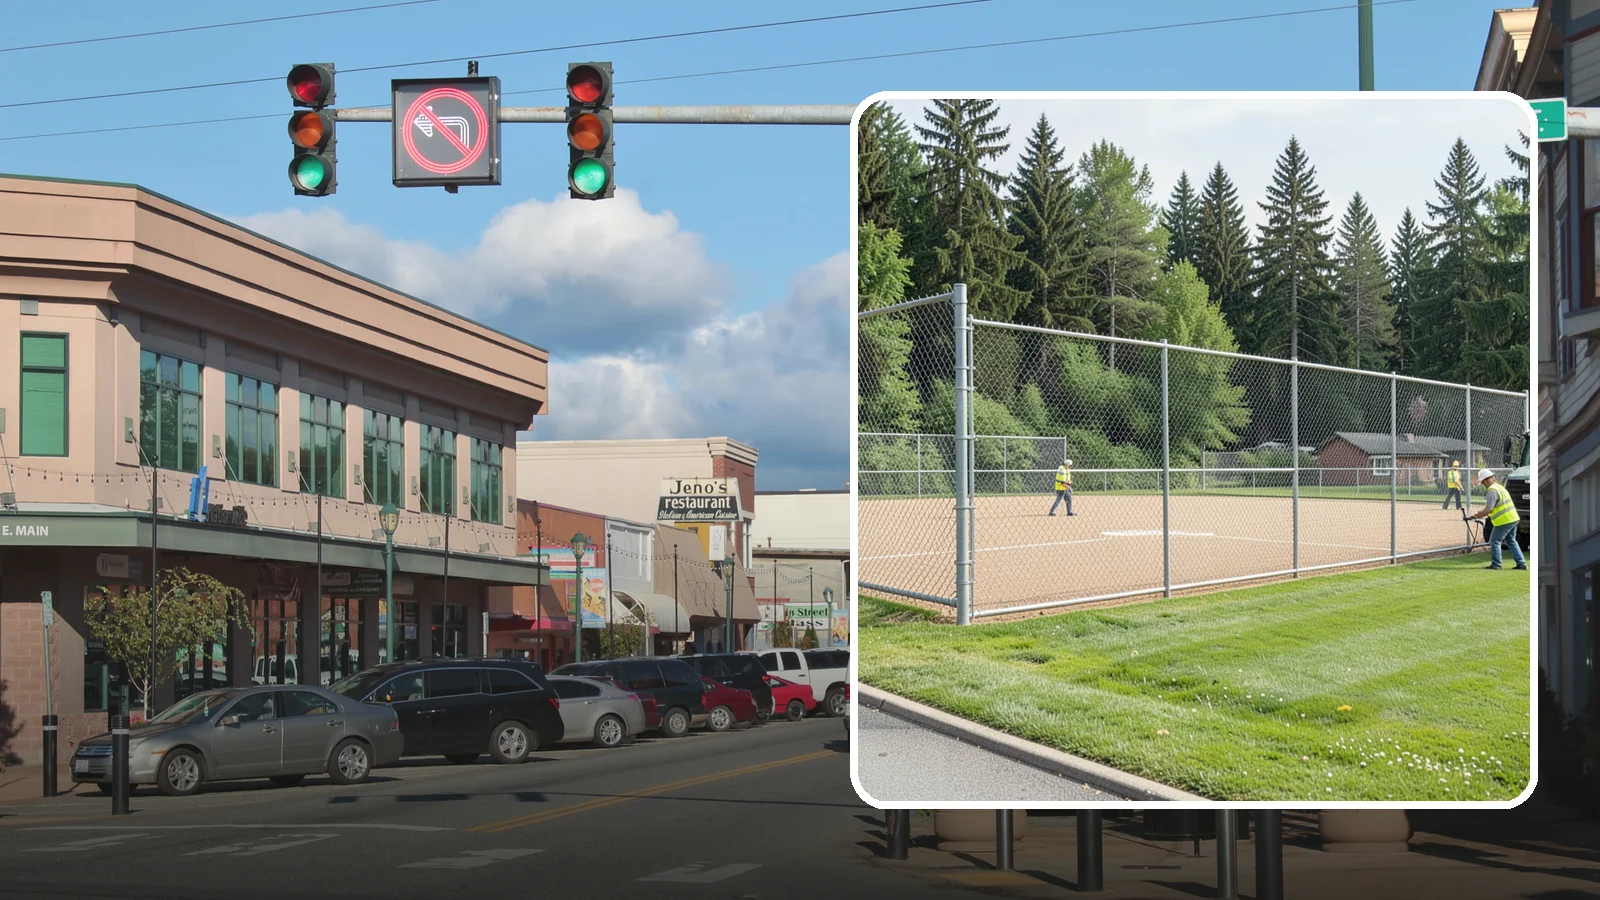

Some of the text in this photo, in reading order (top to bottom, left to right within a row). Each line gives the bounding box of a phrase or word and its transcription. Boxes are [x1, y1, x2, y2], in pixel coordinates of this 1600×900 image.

[669, 480, 727, 494] Jeno's
[665, 496, 731, 509] restaurant
[658, 510, 681, 519] Italian
[686, 510, 714, 519] American
[715, 509, 738, 519] Cuisine
[2, 525, 49, 536] E. MAIN
[797, 607, 828, 617] Street
[791, 619, 824, 627] lass
